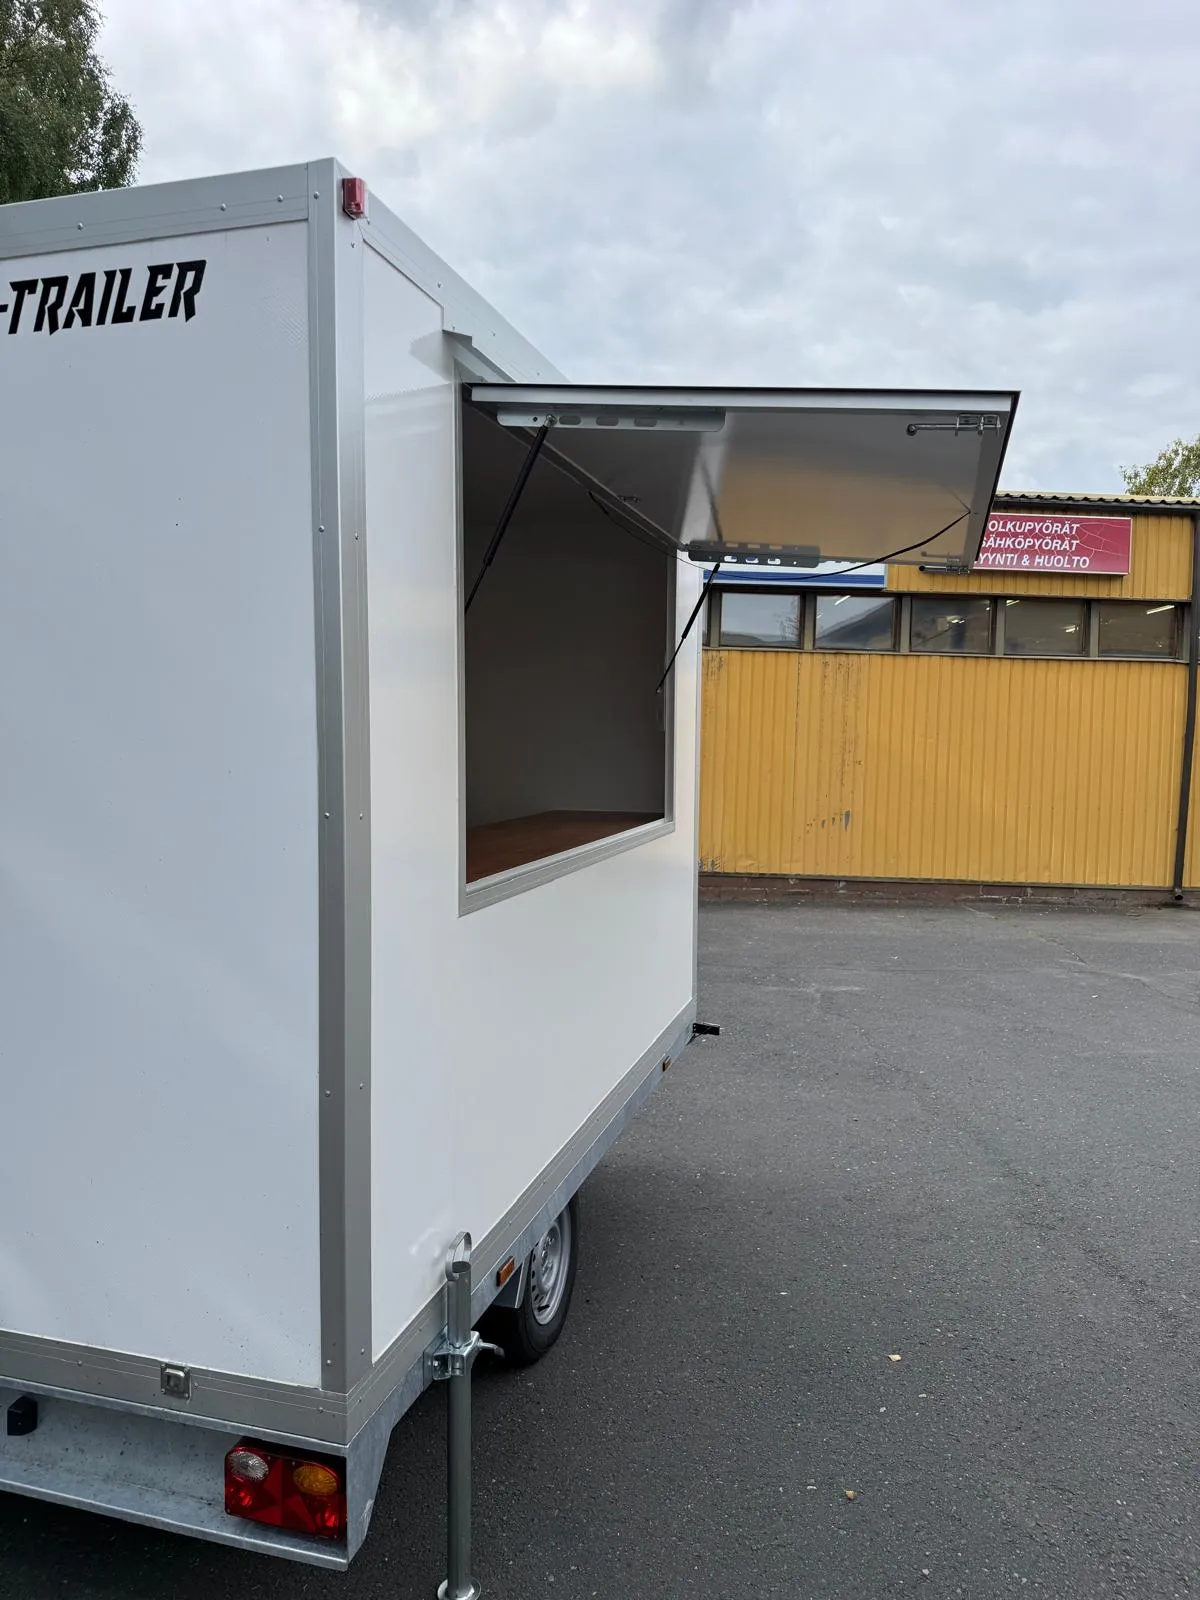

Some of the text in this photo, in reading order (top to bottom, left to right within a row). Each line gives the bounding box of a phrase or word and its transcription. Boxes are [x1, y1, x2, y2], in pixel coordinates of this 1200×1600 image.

[988, 520, 1080, 535] OLKUPYÖRÄT
[975, 552, 1090, 569] YYNTI & HUOLTO
